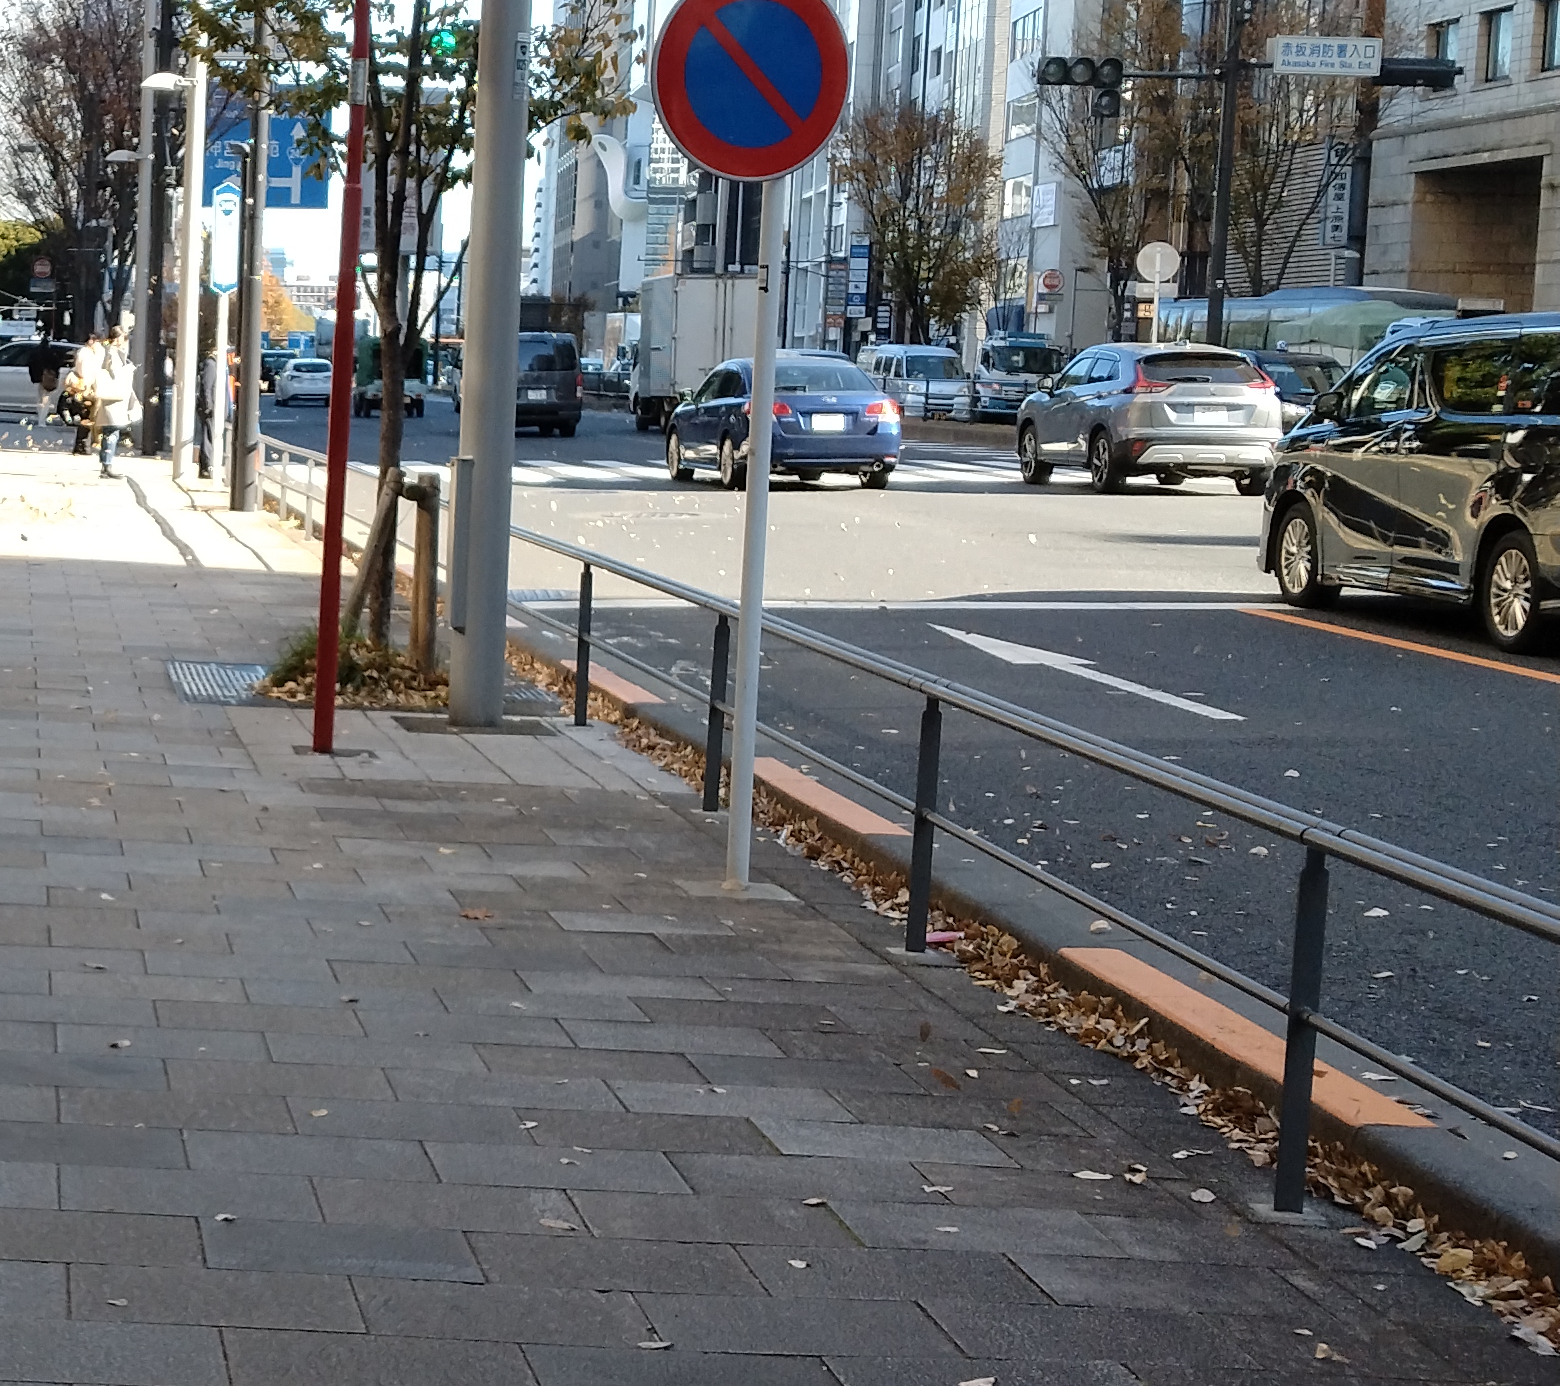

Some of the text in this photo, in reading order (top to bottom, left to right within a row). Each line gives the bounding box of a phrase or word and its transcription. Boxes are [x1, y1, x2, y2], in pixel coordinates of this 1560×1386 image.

[1281, 42, 1376, 59] 赤坂消防署入口
[1280, 59, 1316, 68] Akasaka
